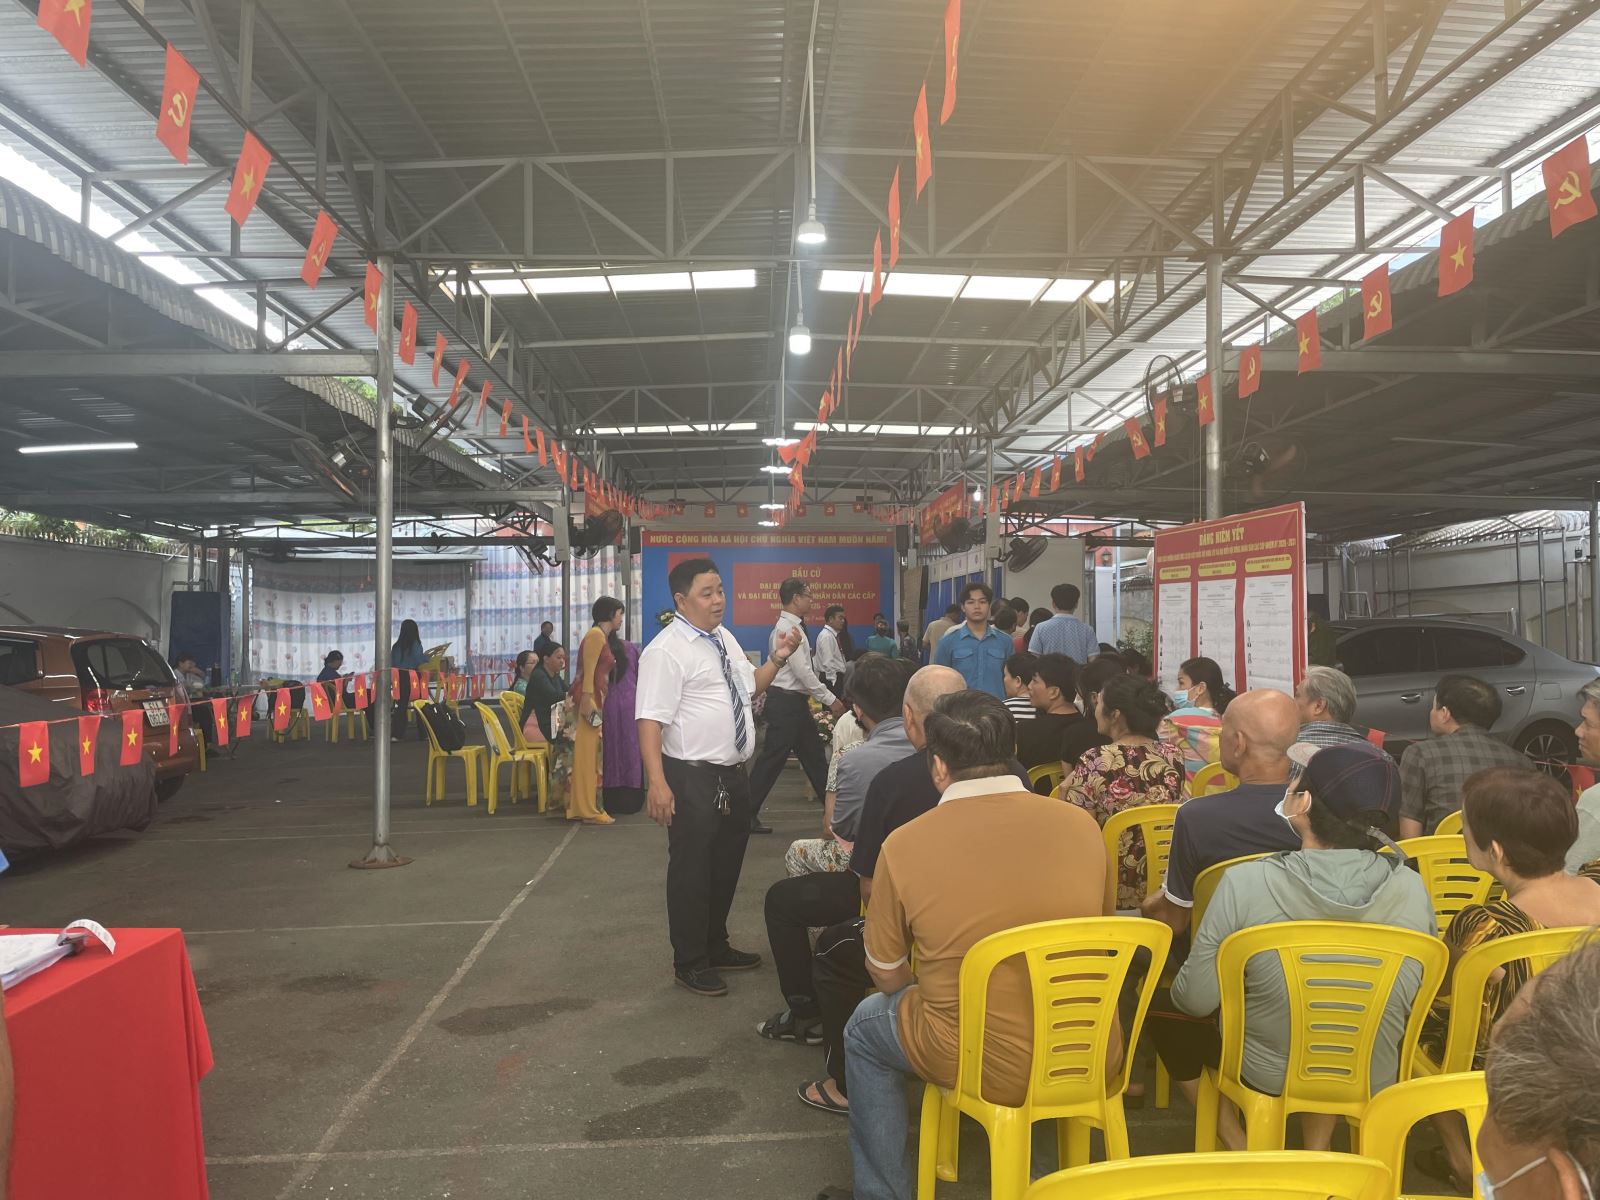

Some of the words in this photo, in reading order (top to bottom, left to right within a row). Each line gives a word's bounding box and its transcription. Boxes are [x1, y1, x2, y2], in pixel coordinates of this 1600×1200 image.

[650, 534, 673, 544] NƯỚC
[676, 534, 699, 544] CỘNG
[798, 534, 816, 544] VIỆT
[818, 535, 837, 544] NAM
[792, 566, 808, 578] BẦU
[810, 566, 821, 578] CỬ
[760, 582, 771, 590] ĐẠI
[810, 582, 821, 590] HỘI
[843, 582, 854, 590] XVI
[748, 592, 760, 600] ĐẠI
[762, 590, 778, 600] BIỂU
